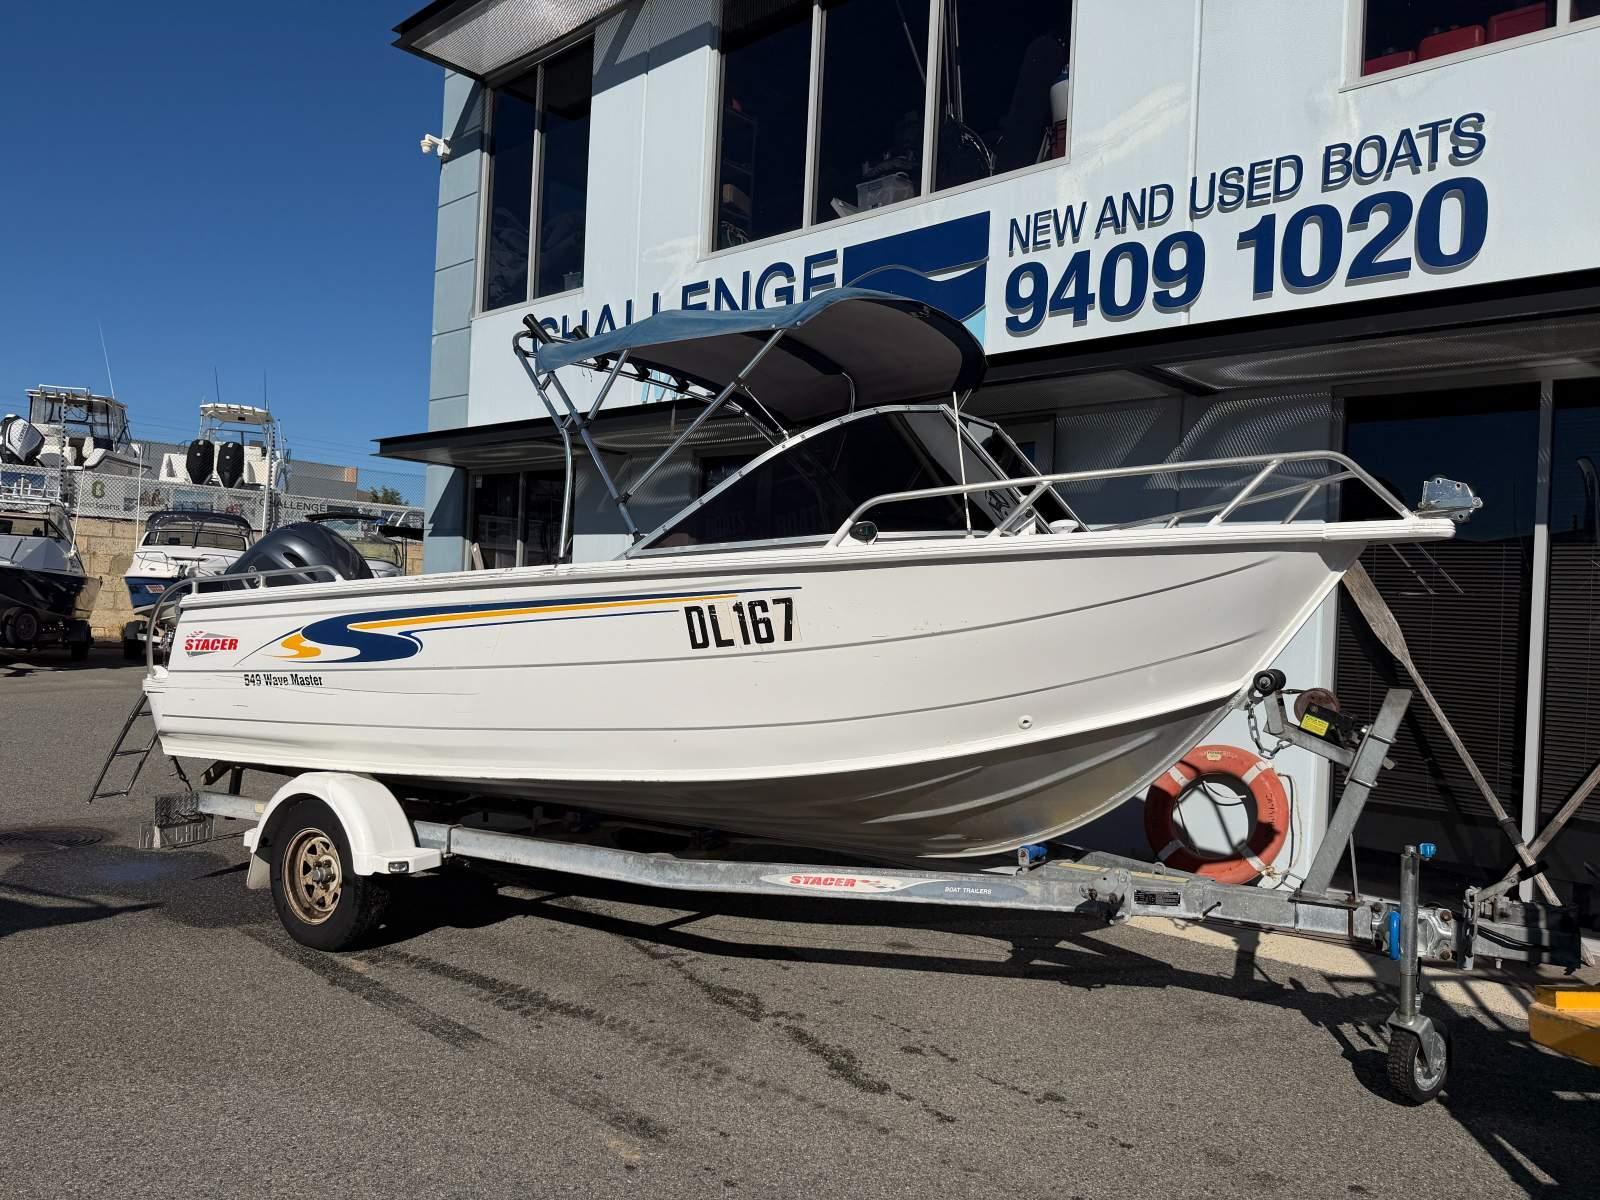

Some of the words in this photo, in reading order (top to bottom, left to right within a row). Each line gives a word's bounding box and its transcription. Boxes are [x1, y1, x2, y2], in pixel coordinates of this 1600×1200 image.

[1009, 202, 1087, 253] NEW
[1096, 183, 1174, 235] AND
[1190, 154, 1304, 218] USED
[1322, 112, 1486, 190] BOATS
[1005, 231, 1206, 335] 9409
[1238, 176, 1489, 299] 1020
[532, 249, 838, 352] CHAENGE
[259, 498, 328, 513] CALLENGE
[684, 597, 793, 649] DL167
[184, 638, 239, 651] STACER
[243, 674, 262, 686] 549
[264, 673, 289, 686] Wave
[290, 673, 323, 686] Master
[789, 875, 857, 888] STACER
[963, 887, 992, 895] TRAILERS
